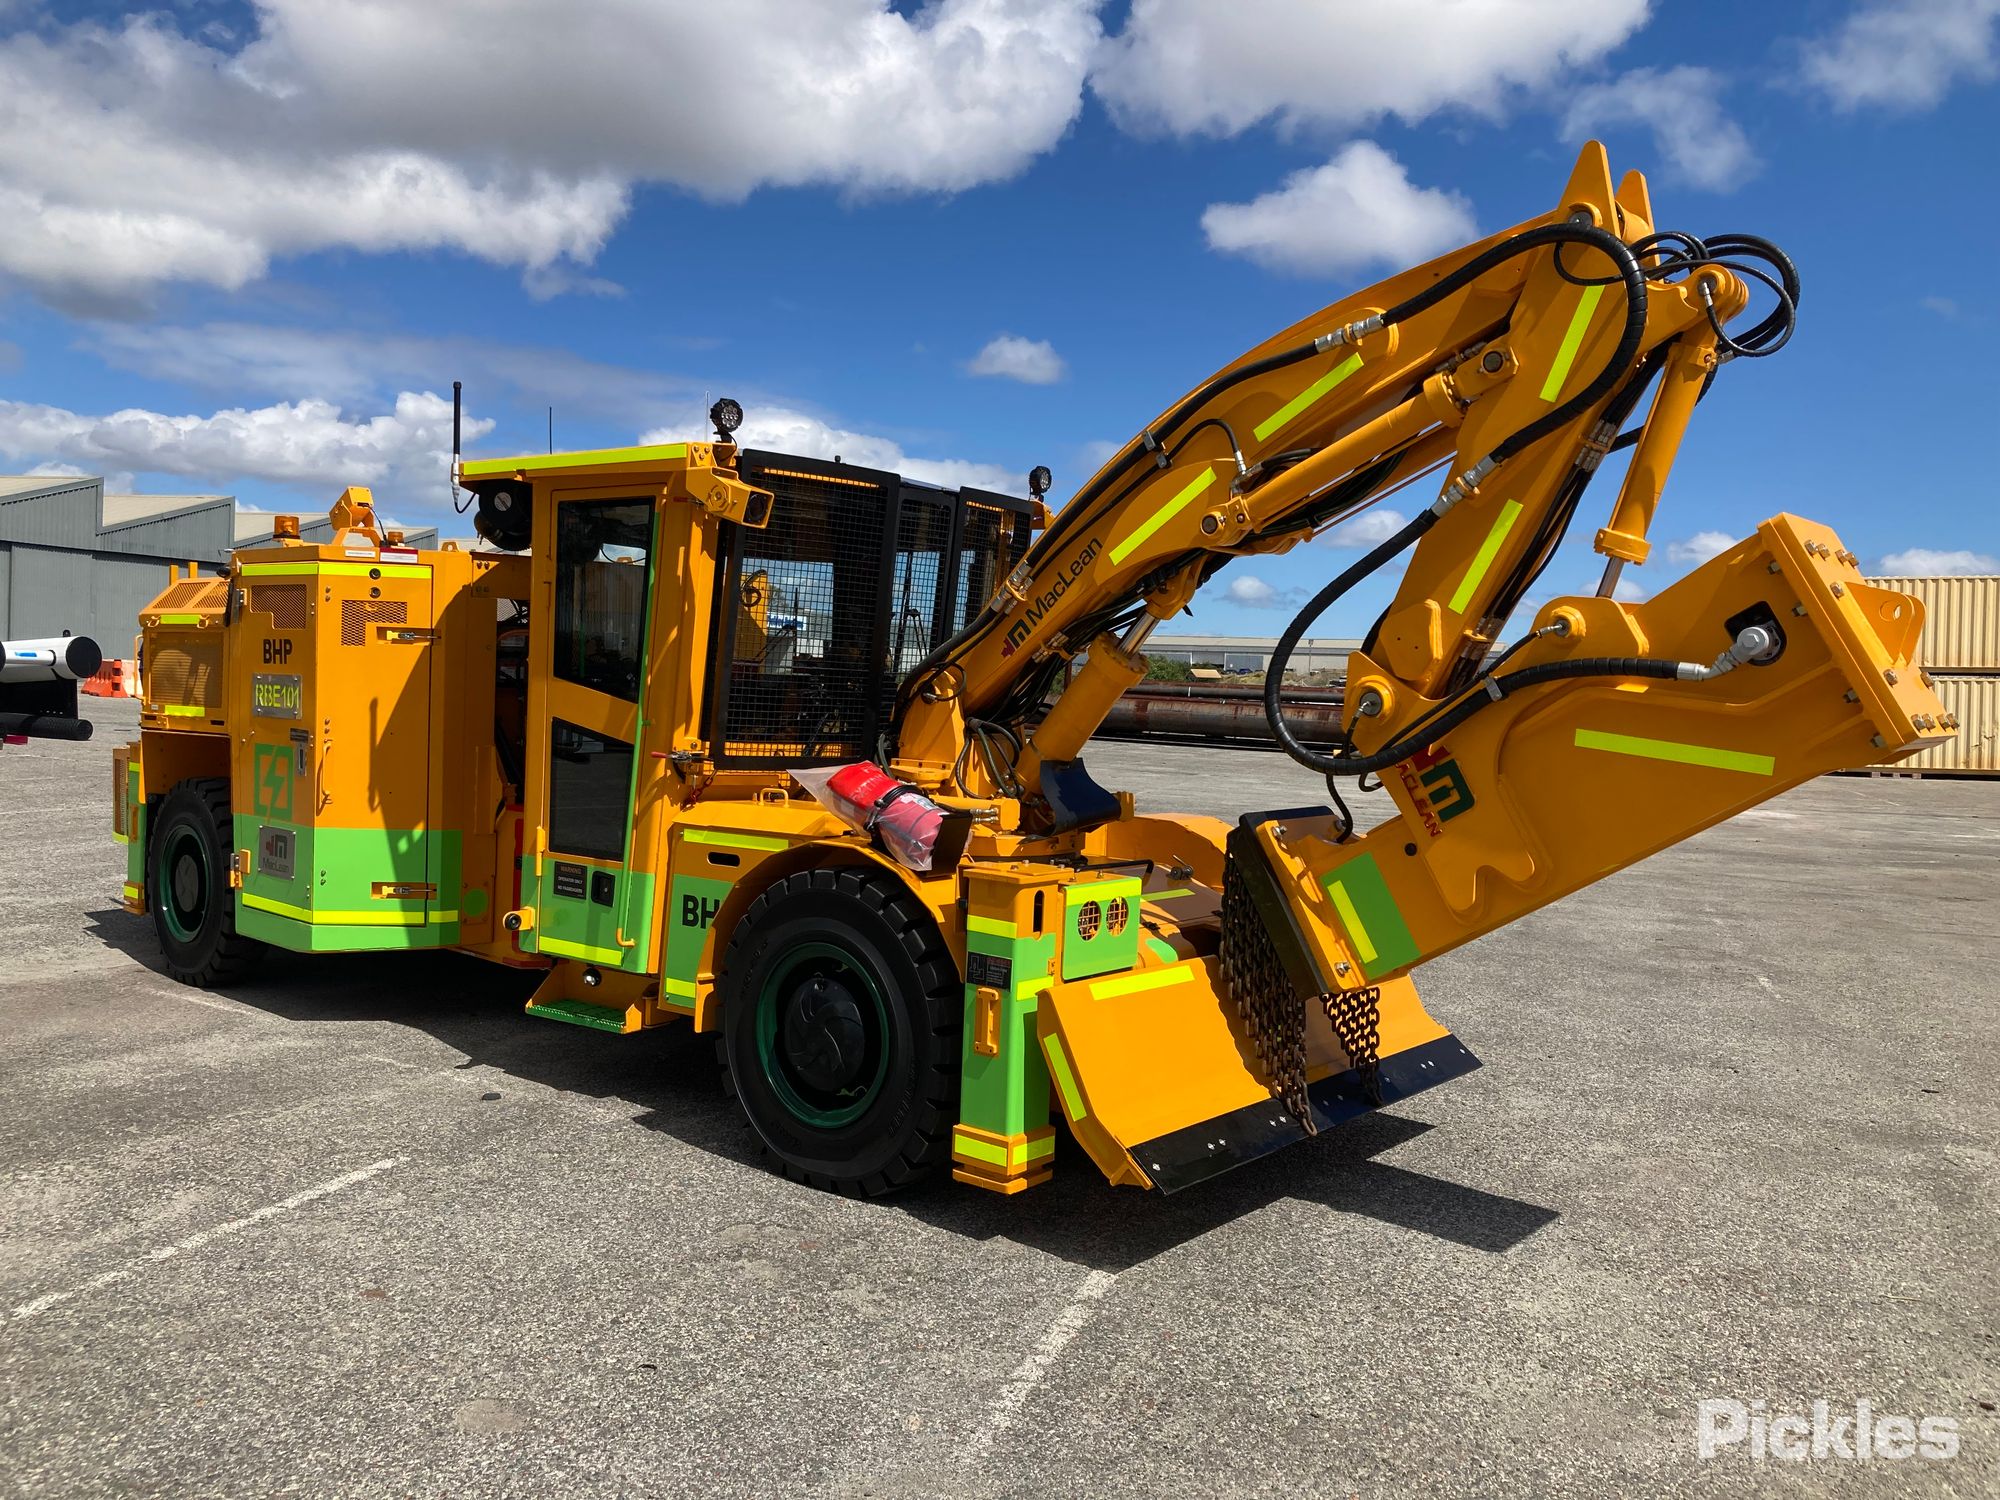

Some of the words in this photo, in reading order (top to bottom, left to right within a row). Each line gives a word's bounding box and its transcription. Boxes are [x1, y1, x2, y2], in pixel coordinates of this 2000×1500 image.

[1025, 538, 1102, 626] MacLean
[263, 638, 292, 664] BHP
[255, 683, 300, 709] RBE101
[1395, 763, 1443, 837] ACLEAN
[262, 856, 289, 873] MacLean
[682, 894, 720, 929] BH
